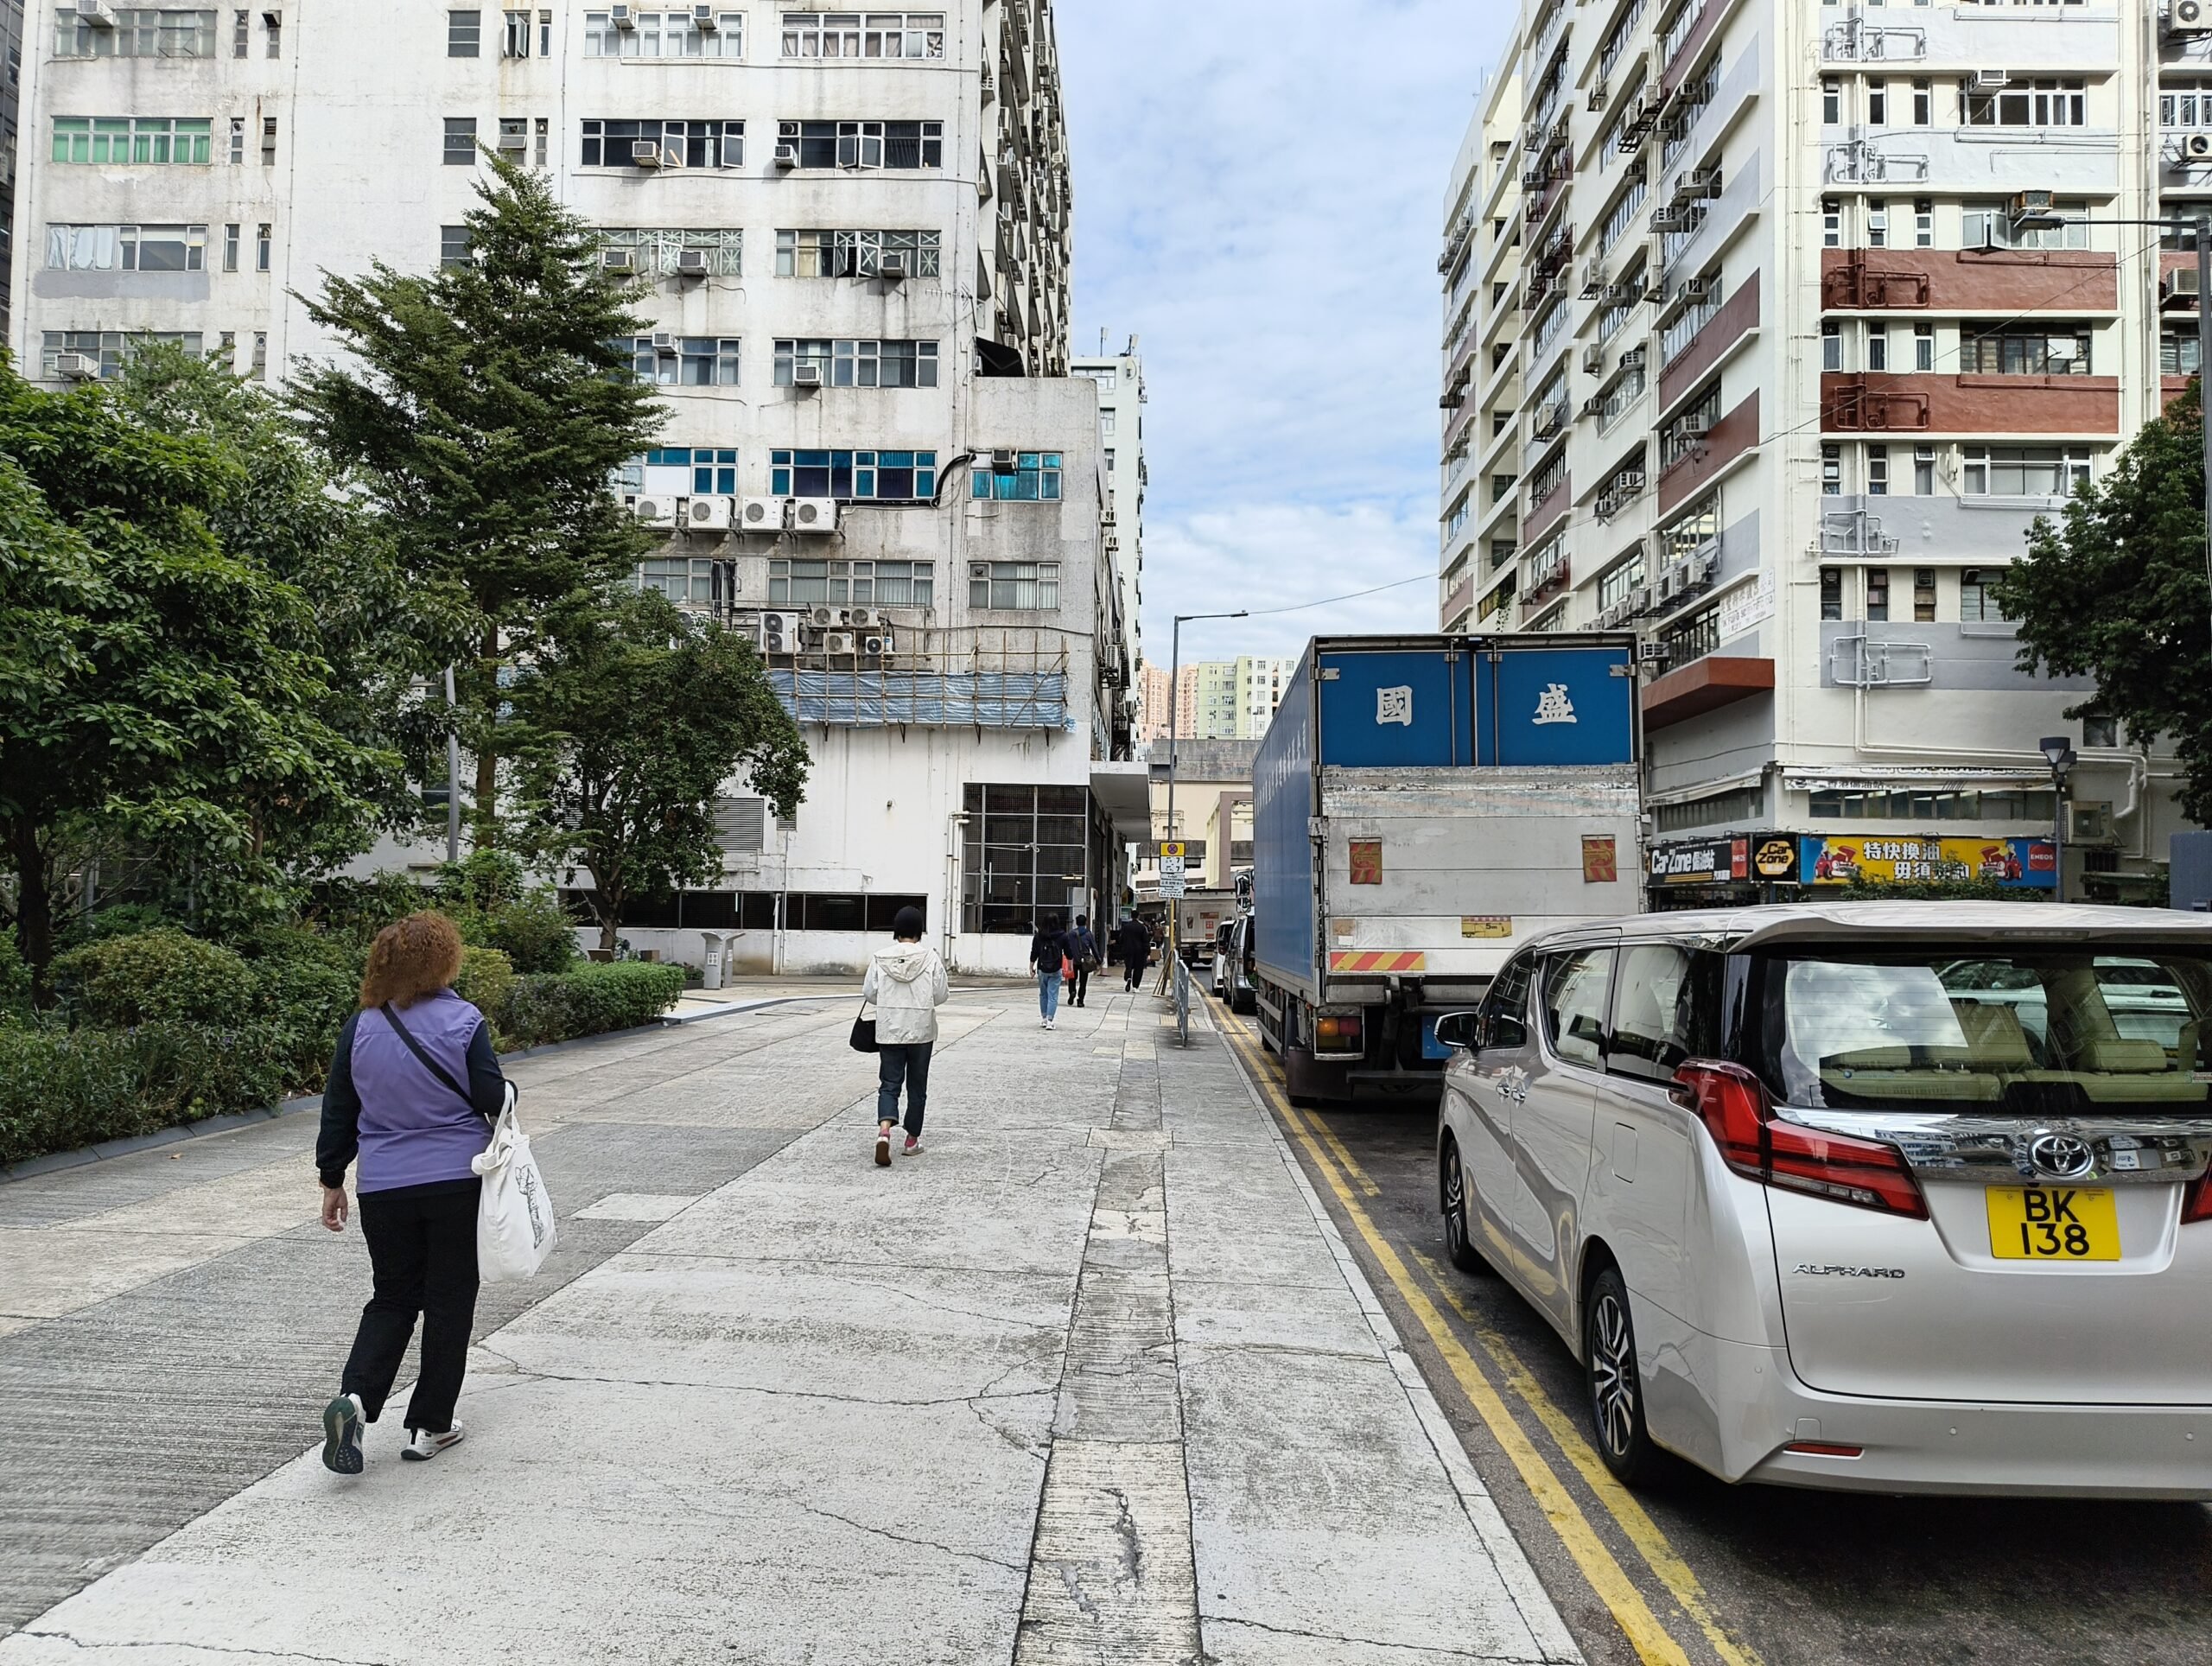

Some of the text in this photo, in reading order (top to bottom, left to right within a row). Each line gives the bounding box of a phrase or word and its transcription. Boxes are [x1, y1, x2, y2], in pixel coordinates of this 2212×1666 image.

[1376, 683, 1579, 727] 國 盛
[1758, 853, 1789, 864] Zone
[1767, 843, 1790, 855] Car
[1863, 840, 1941, 861] 特快換油
[1651, 849, 1669, 874] Car
[1668, 848, 1692, 873] Zone
[2024, 1190, 2079, 1223] BK
[2020, 1223, 2090, 1256] 138
[1791, 1262, 1906, 1279] ALPHARD
